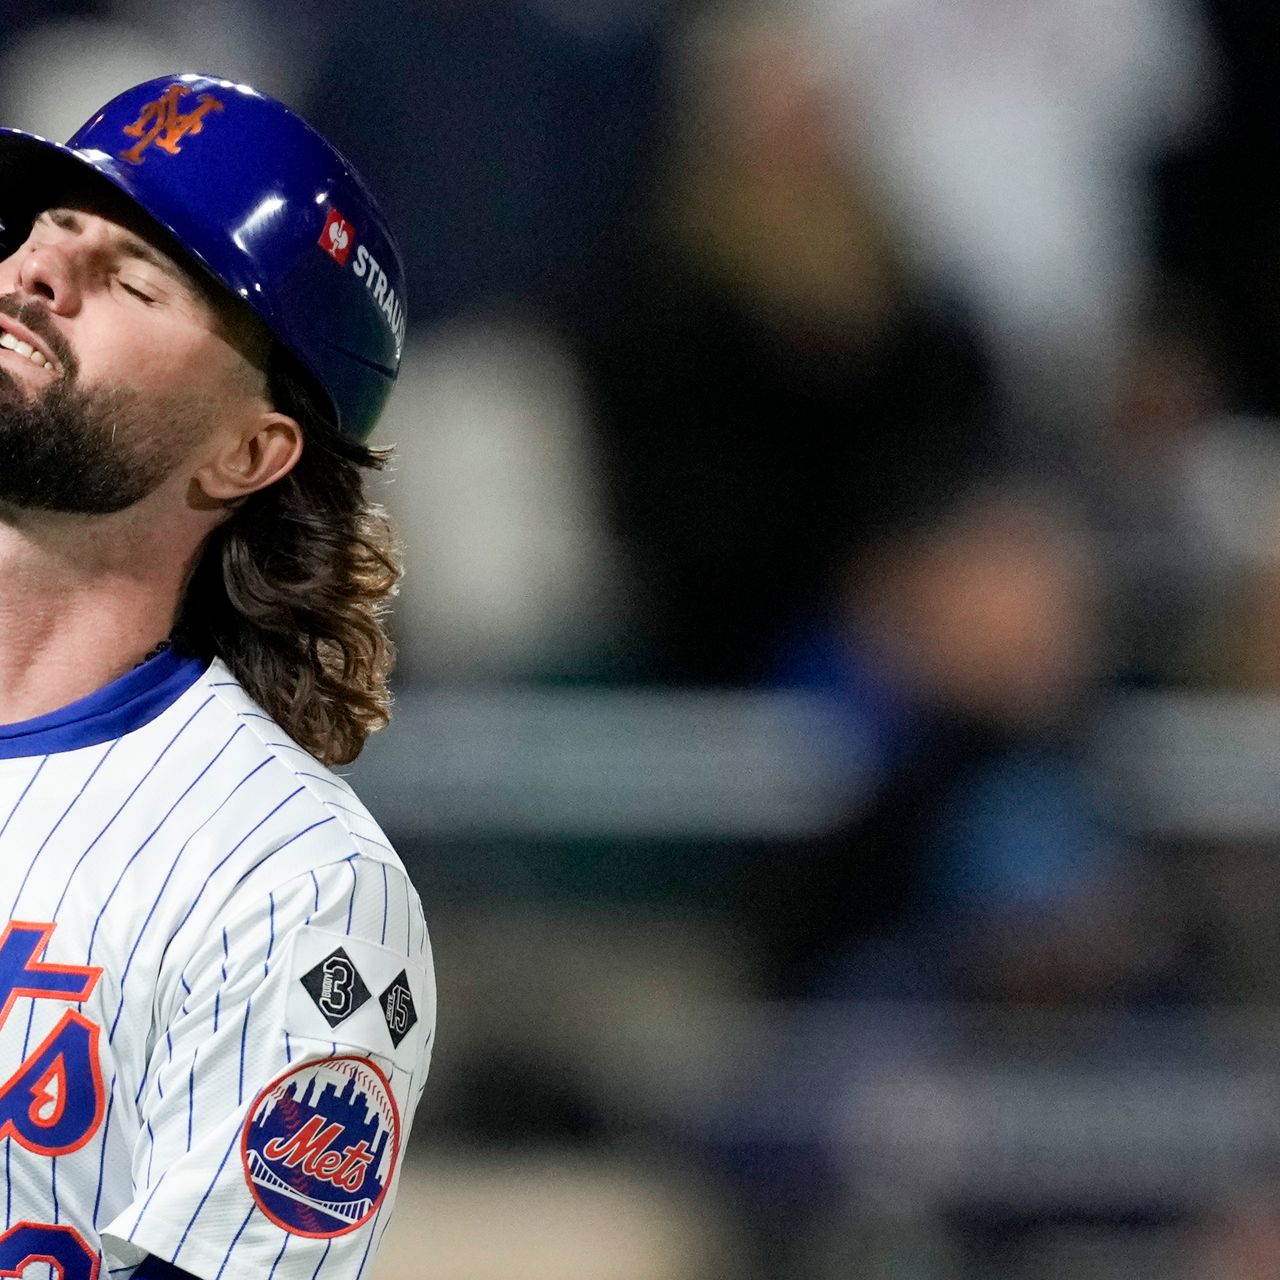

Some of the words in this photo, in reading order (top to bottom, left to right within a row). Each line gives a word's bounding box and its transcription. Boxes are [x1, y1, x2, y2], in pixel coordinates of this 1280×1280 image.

[352, 244, 406, 354] STRAUS
[320, 957, 354, 1017] 3
[390, 985, 411, 1033] 15
[263, 1114, 375, 1193] Mets
